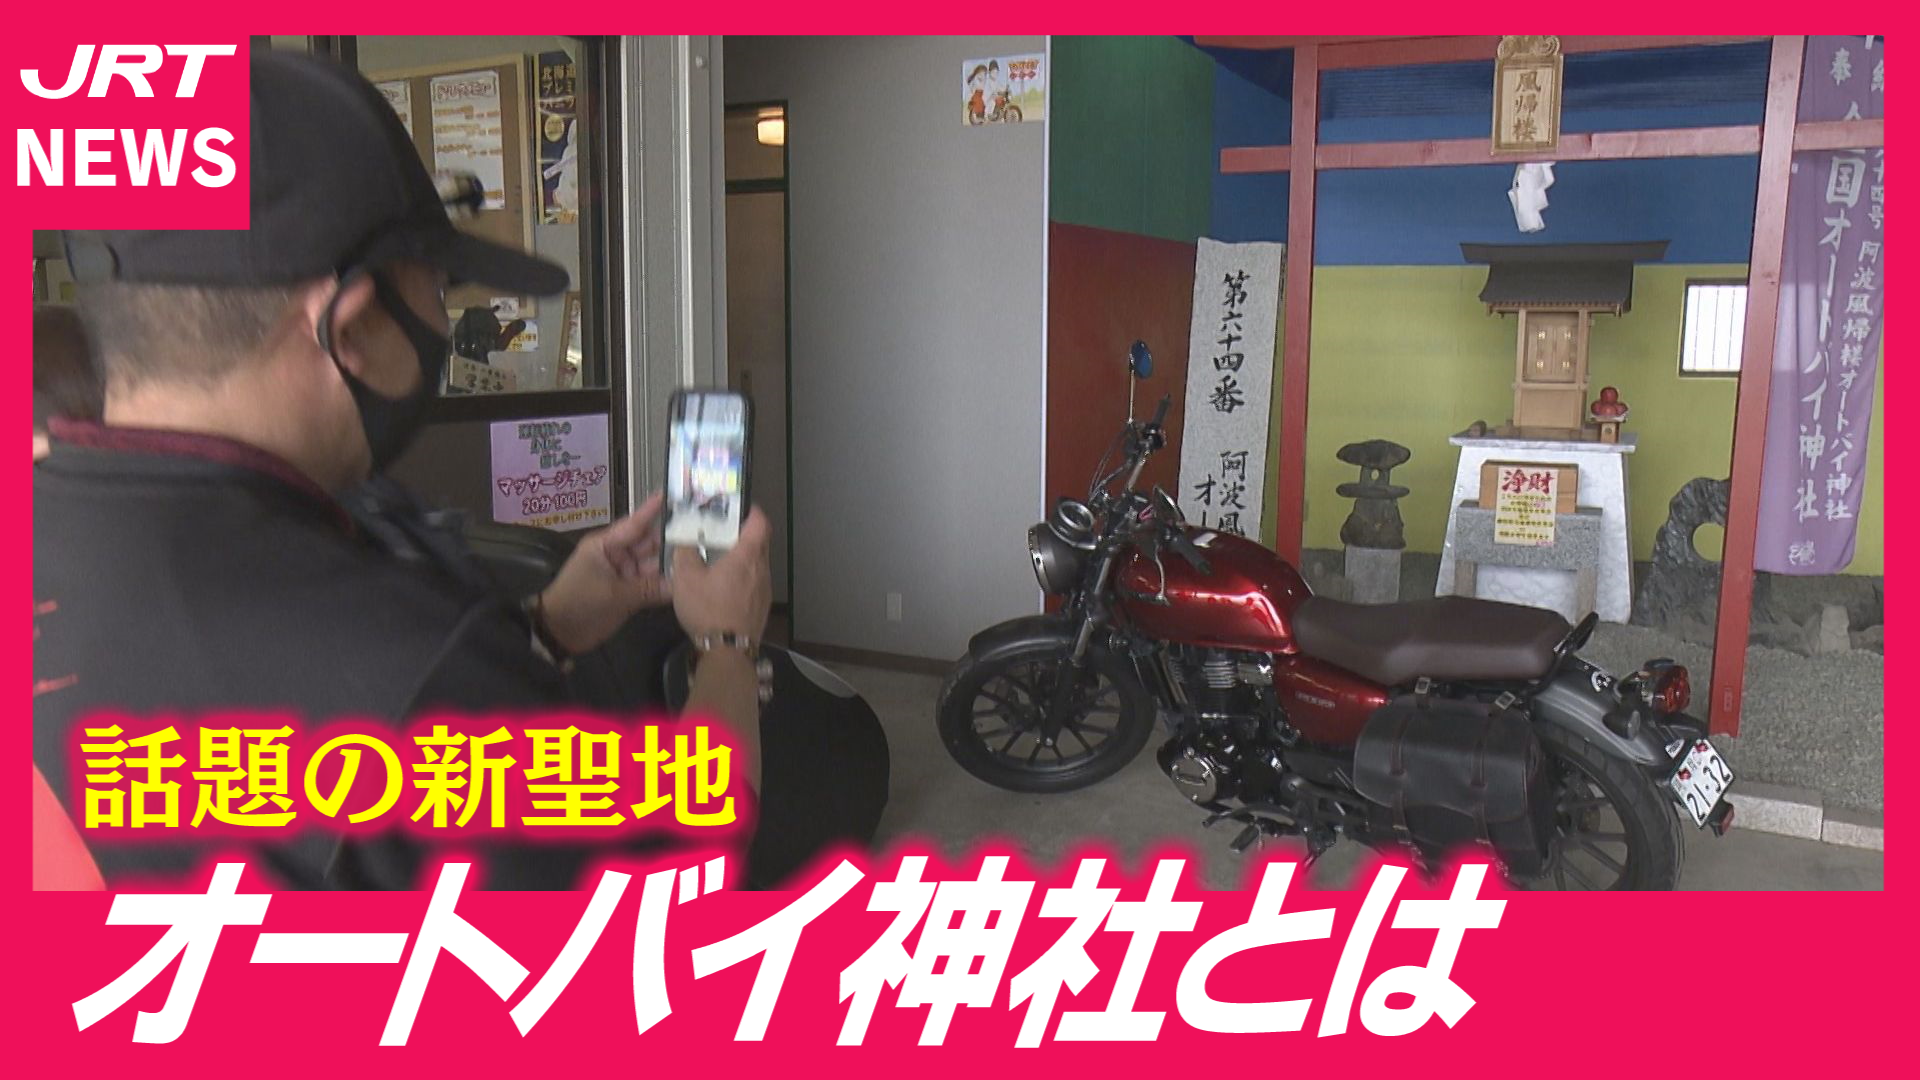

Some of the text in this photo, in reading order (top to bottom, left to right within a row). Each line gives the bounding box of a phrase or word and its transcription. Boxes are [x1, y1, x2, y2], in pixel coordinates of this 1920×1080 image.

[1513, 70, 1542, 142] 風帰楼
[1208, 269, 1251, 414] 第六十四番
[497, 464, 607, 498] マッサージチェア
[1502, 468, 1554, 494] 浄財
